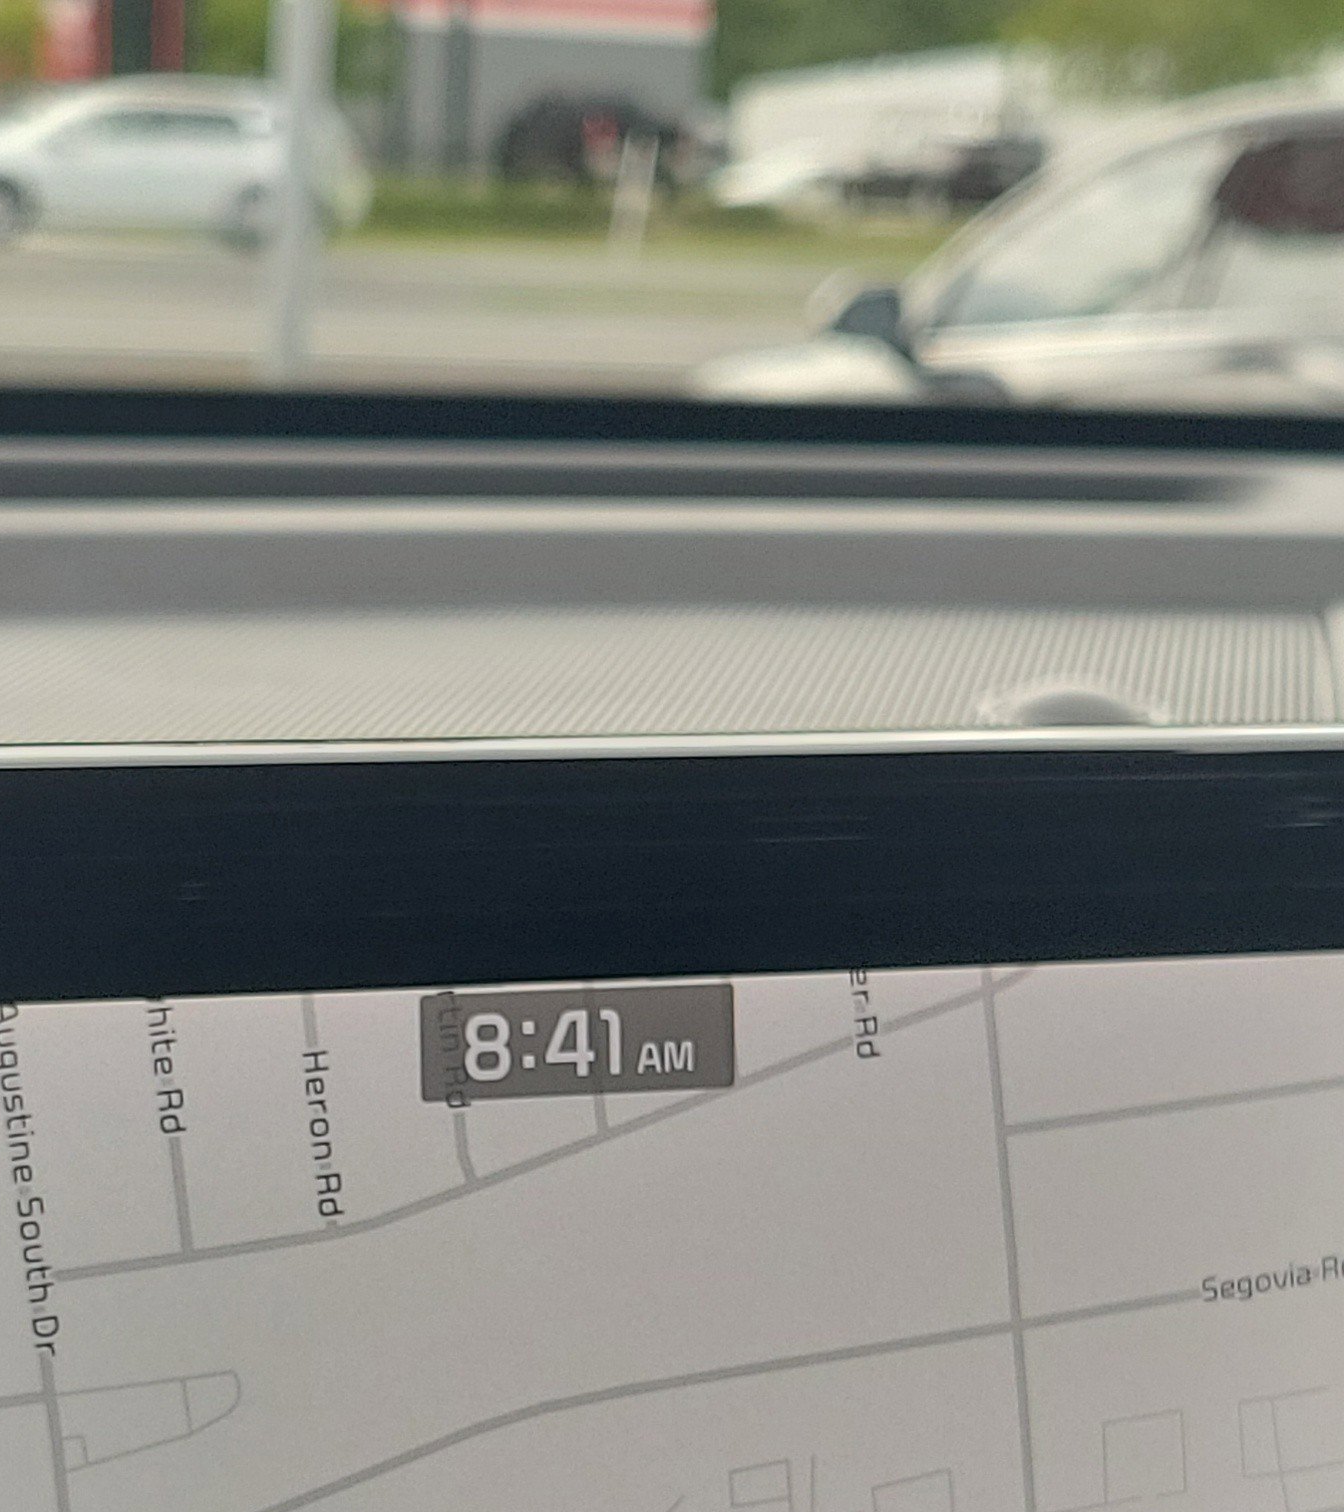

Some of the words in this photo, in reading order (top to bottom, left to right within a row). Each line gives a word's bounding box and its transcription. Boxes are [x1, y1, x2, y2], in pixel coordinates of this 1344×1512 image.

[146, 1002, 178, 1076] hite
[463, 1008, 623, 1082] 8:41
[636, 1040, 695, 1076] AM
[854, 1016, 881, 1059] Rd
[156, 1088, 187, 1135] Rd
[301, 1048, 335, 1162] Heron
[316, 1171, 345, 1219] Rd
[16, 1197, 52, 1306] South
[1200, 1261, 1313, 1302] Segovia
[32, 1314, 60, 1356] Dr
